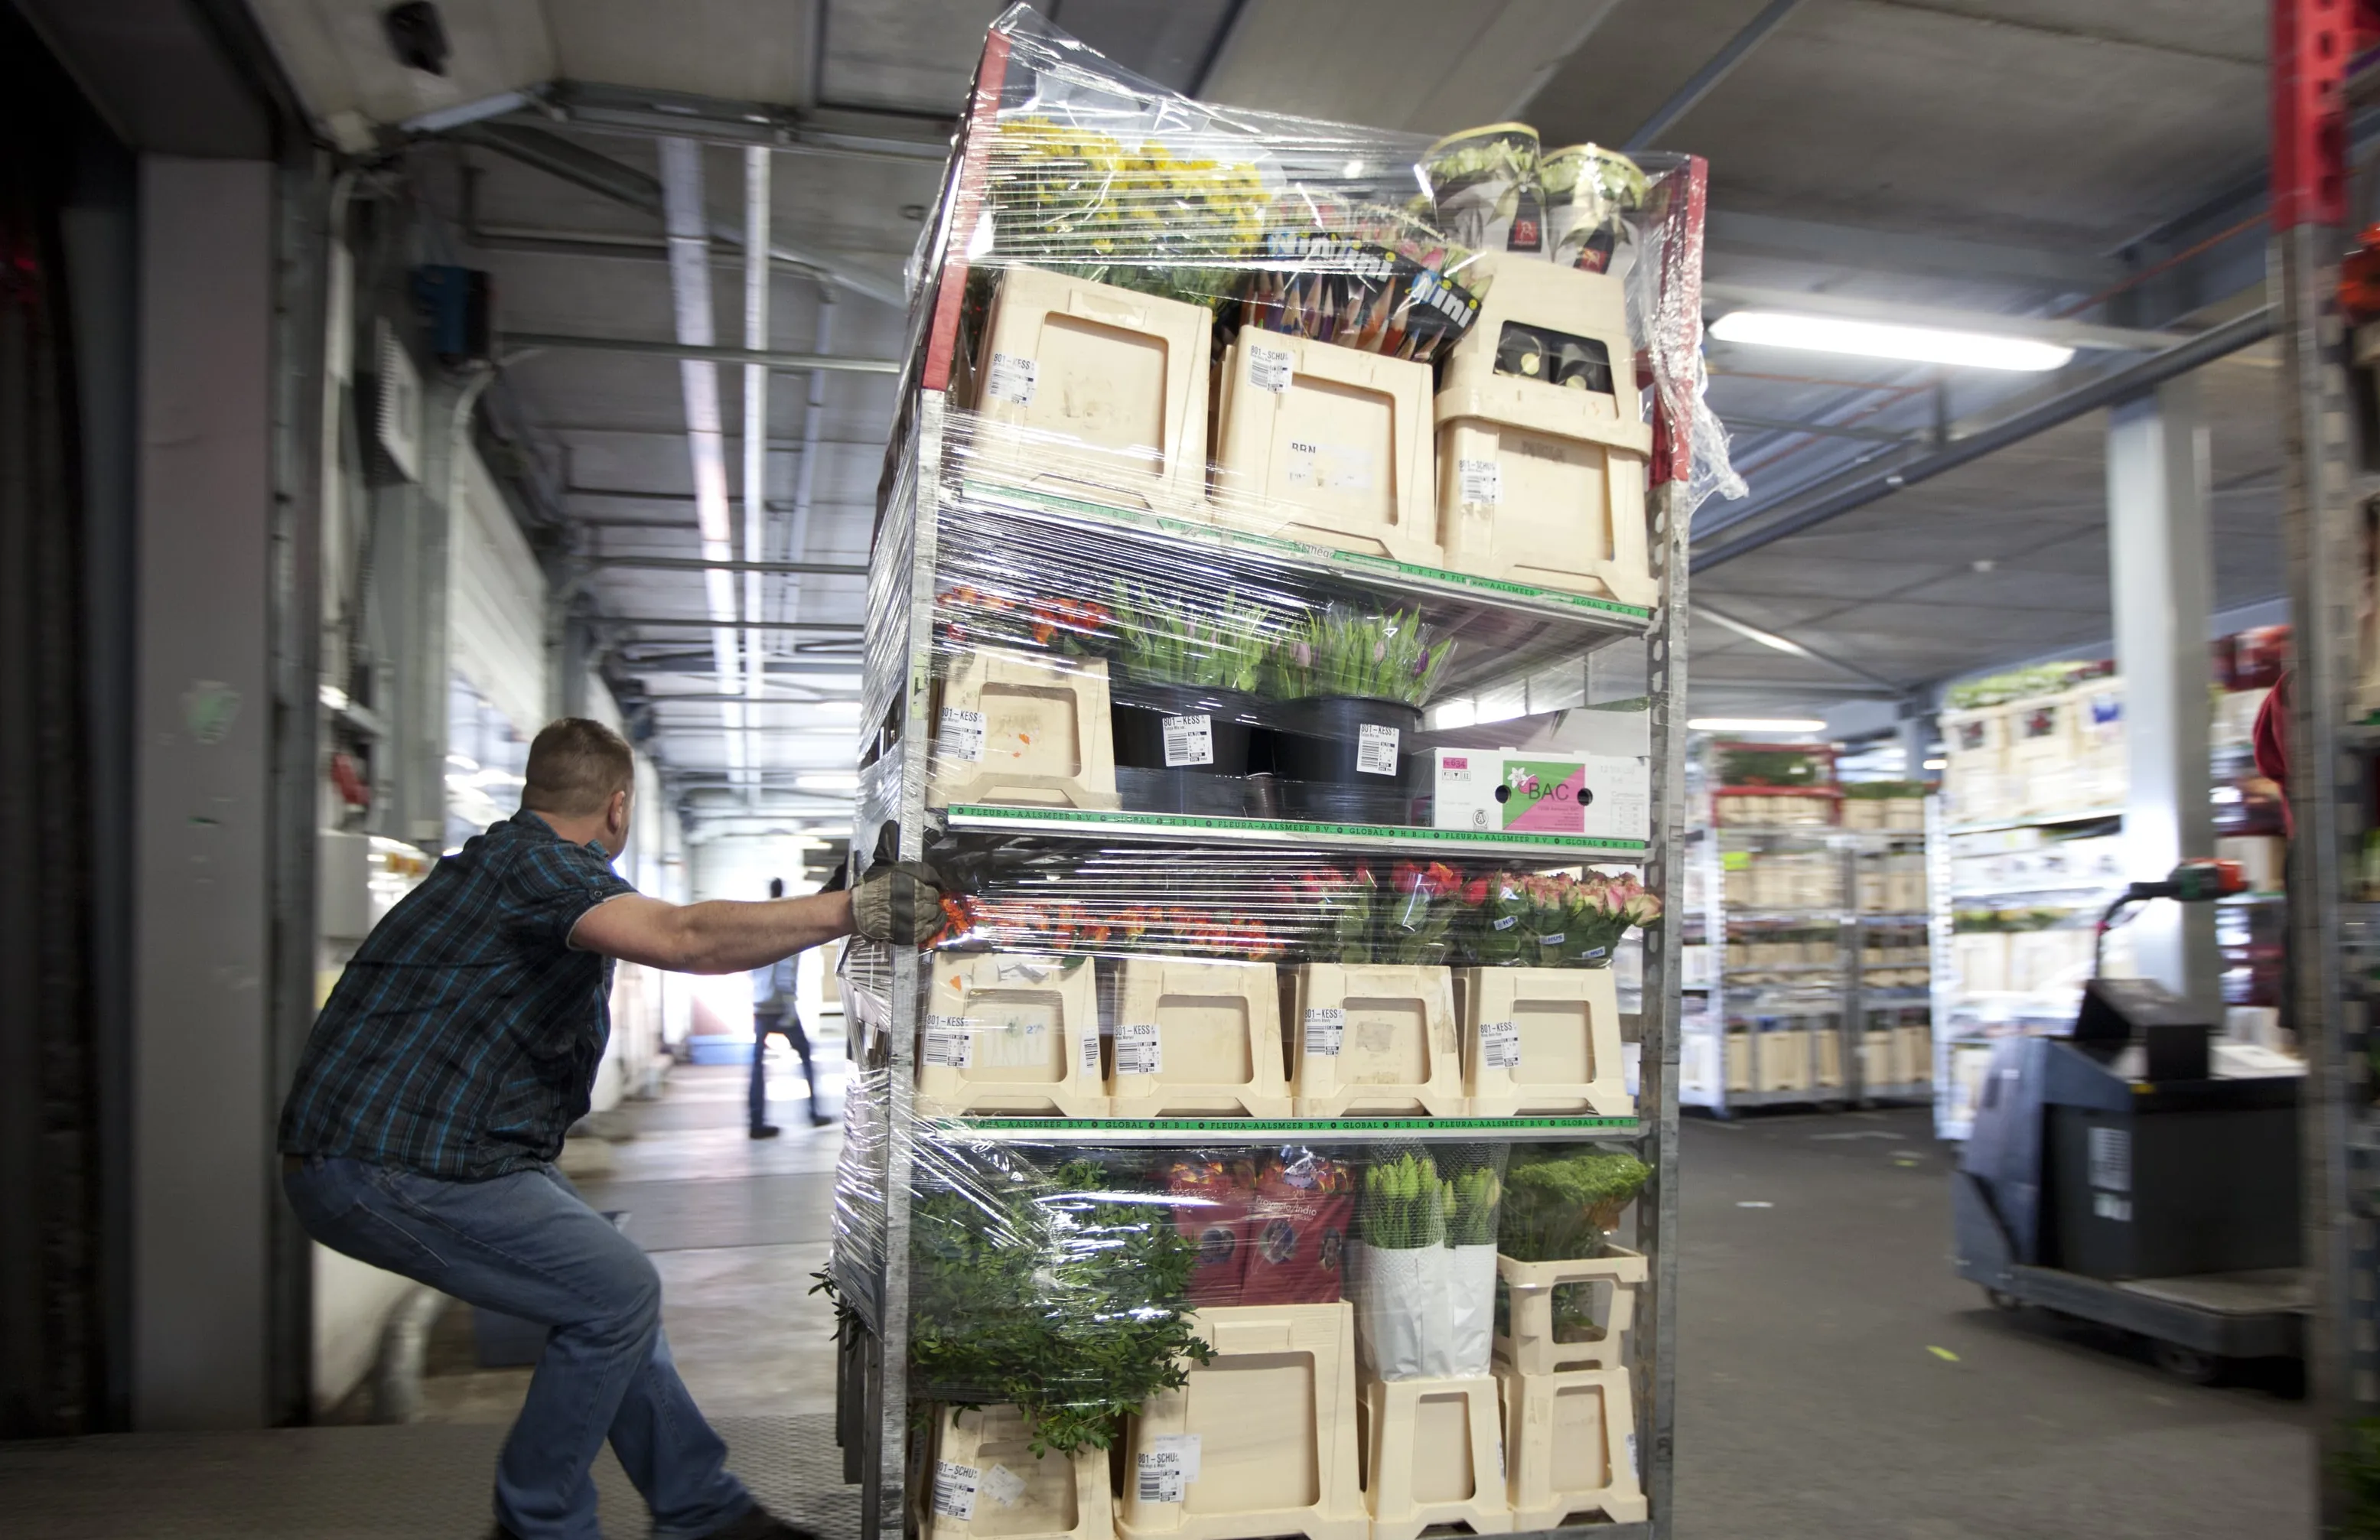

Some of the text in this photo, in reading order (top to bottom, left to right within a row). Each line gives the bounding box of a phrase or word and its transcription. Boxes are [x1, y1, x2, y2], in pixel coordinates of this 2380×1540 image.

[1164, 715, 1200, 726] 801-KESS
[1529, 783, 1569, 801] BAC
[971, 809, 1071, 820] FLEURA-AALSMEER
[1218, 821, 1310, 832] FLEURA-AALSMEER
[1350, 828, 1384, 836] GLOBAL
[1446, 833, 1529, 843] FLEURA-AALSMEER
[1565, 838, 1597, 847] GLOBAL
[1304, 1009, 1338, 1018] 801-KESS
[927, 1014, 965, 1027] 801-KESS
[1115, 1024, 1150, 1036] 801-KESS
[1480, 1022, 1512, 1034] 801-KESS
[965, 1120, 1062, 1128] URA-AALSMEER
[1105, 1121, 1144, 1129] GLOBAL
[1211, 1122, 1304, 1130] FLEURA-AALSMEER
[1138, 1453, 1175, 1463] 801-SCHU
